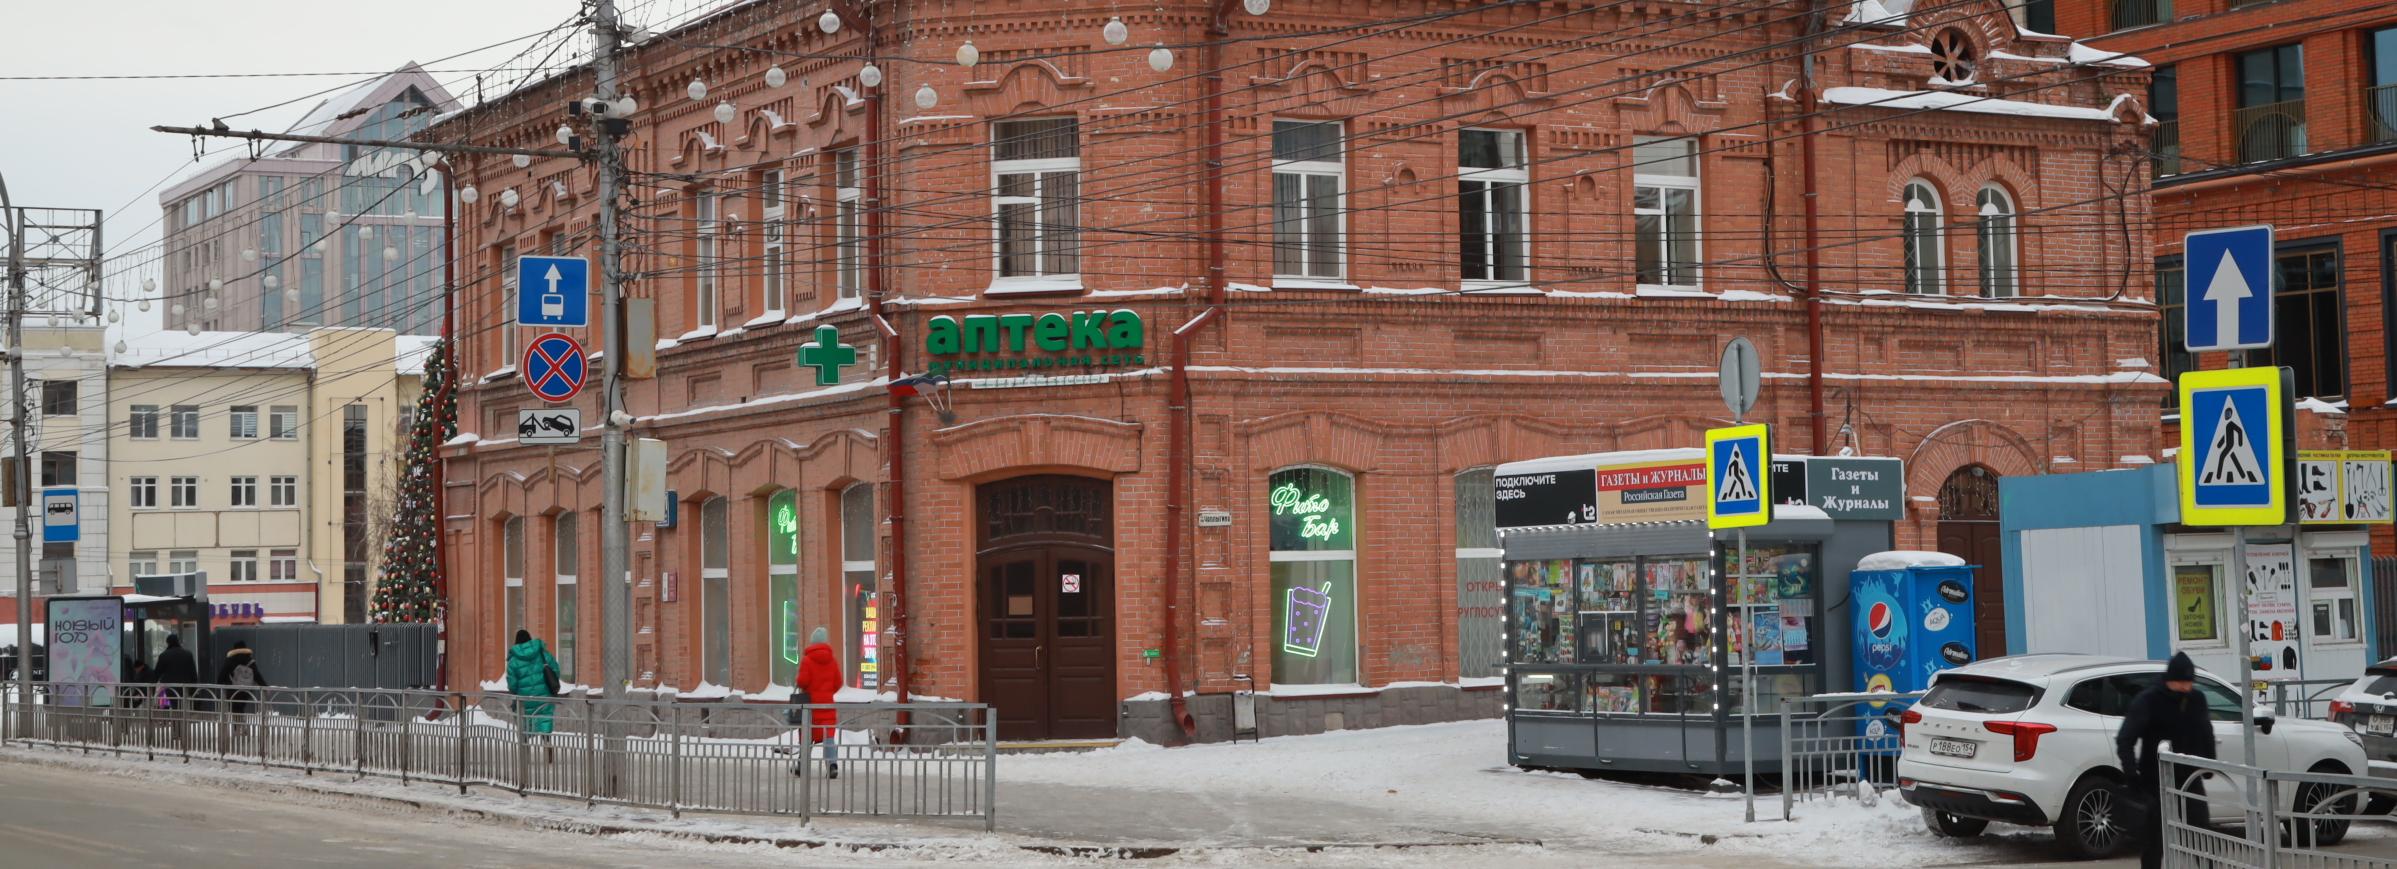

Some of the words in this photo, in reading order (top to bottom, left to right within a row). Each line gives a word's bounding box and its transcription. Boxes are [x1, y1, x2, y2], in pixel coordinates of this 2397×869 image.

[926, 309, 1144, 355] аптека
[1496, 475, 1556, 488] ПОДКЛЮЧИТЕ
[1601, 472, 1641, 487] ГАЗЕТЫ
[1649, 467, 1706, 484] ЖУРНАЛЫ
[1831, 467, 1879, 481] Газеты
[1496, 489, 1526, 500] ЗДЕСЬ
[1624, 490, 1663, 501] Российская
[1663, 488, 1685, 500] Газета
[1851, 485, 1860, 495] и
[1271, 482, 1329, 515] Фито
[1822, 496, 1889, 512] Журналы
[1301, 515, 1339, 541] Бар
[55, 616, 115, 633] НОВЫЙ
[1871, 643, 1893, 654] pepsi
